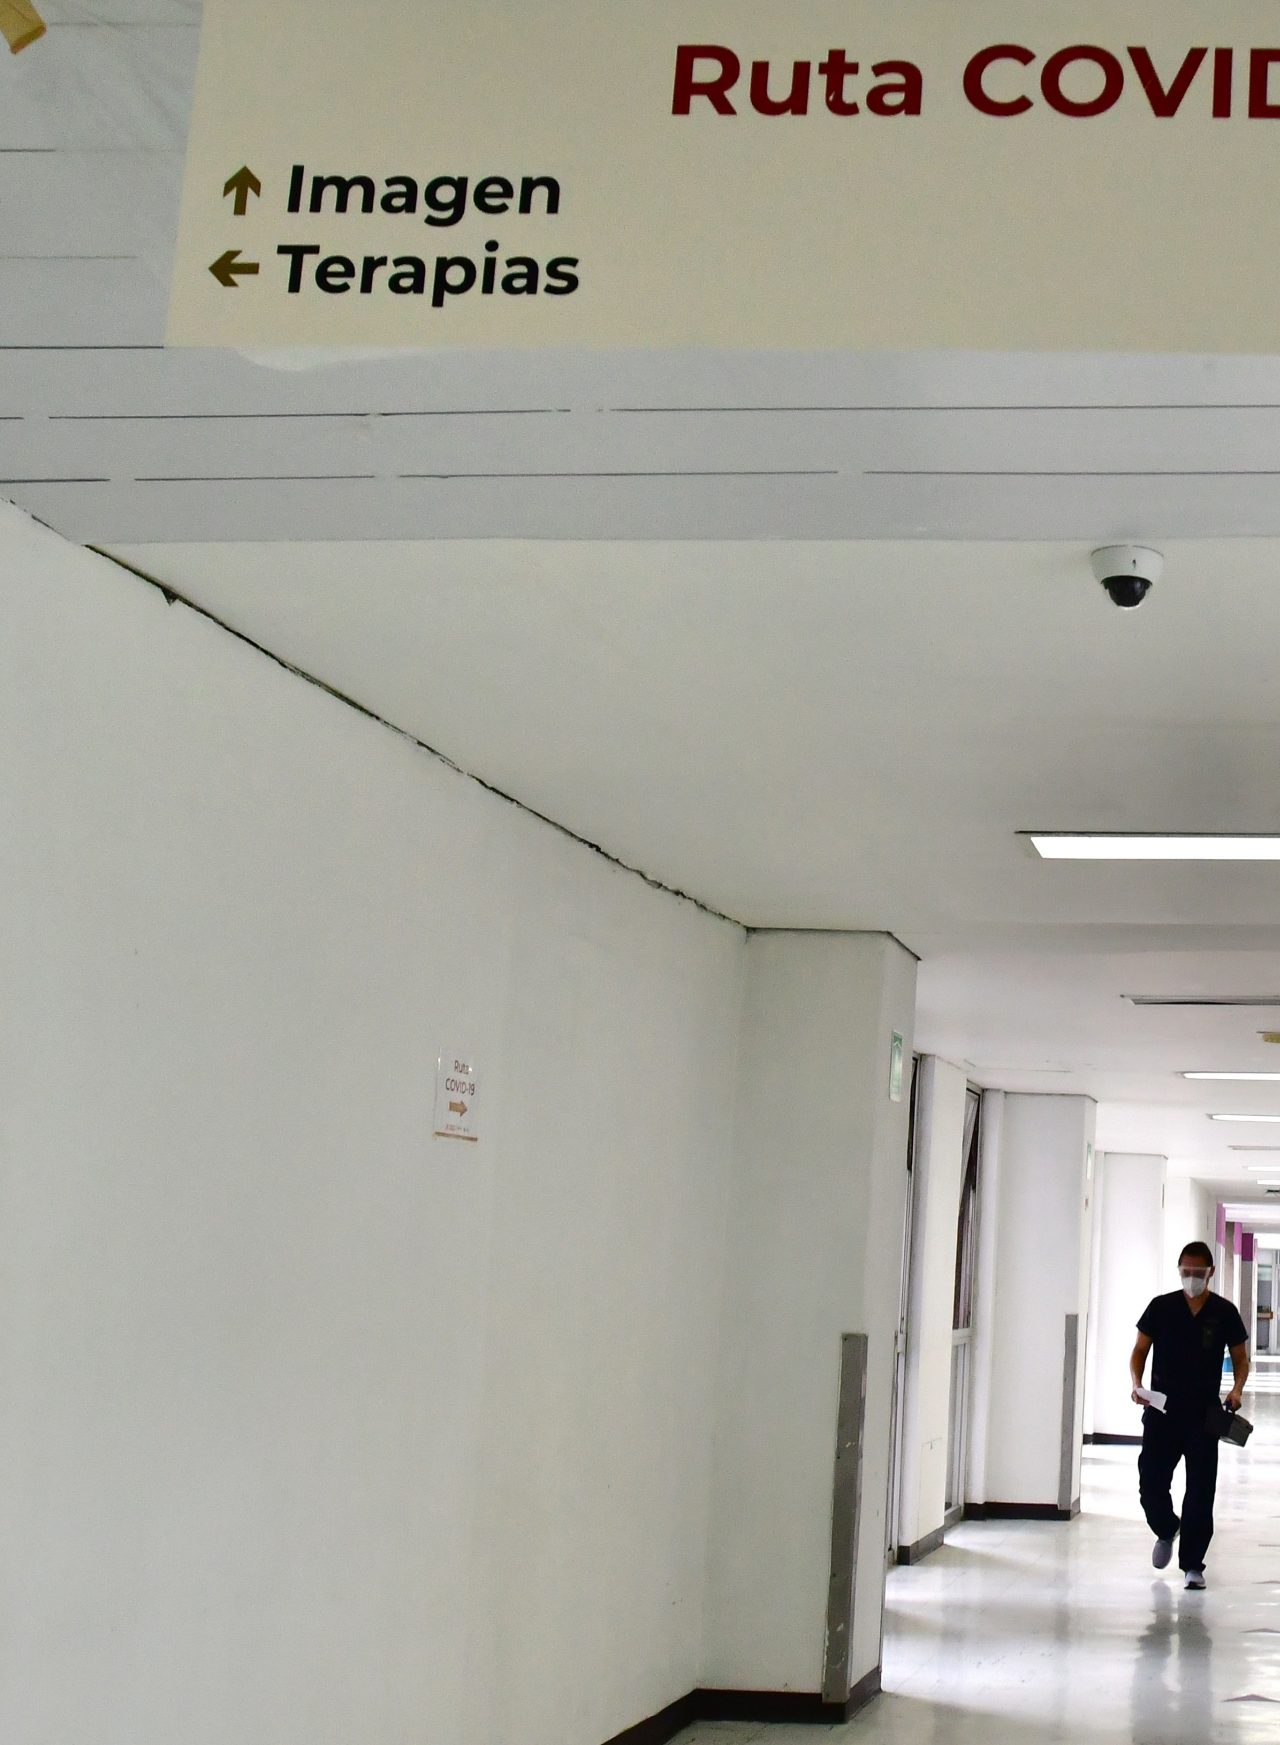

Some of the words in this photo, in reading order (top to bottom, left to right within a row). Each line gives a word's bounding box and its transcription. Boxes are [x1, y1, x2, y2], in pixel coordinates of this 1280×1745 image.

[672, 44, 923, 117] Ruta
[287, 164, 561, 228] Imagen
[276, 239, 580, 308] Terapias
[445, 1078, 475, 1096] COVID-19
[454, 1060, 470, 1075] Ruta
